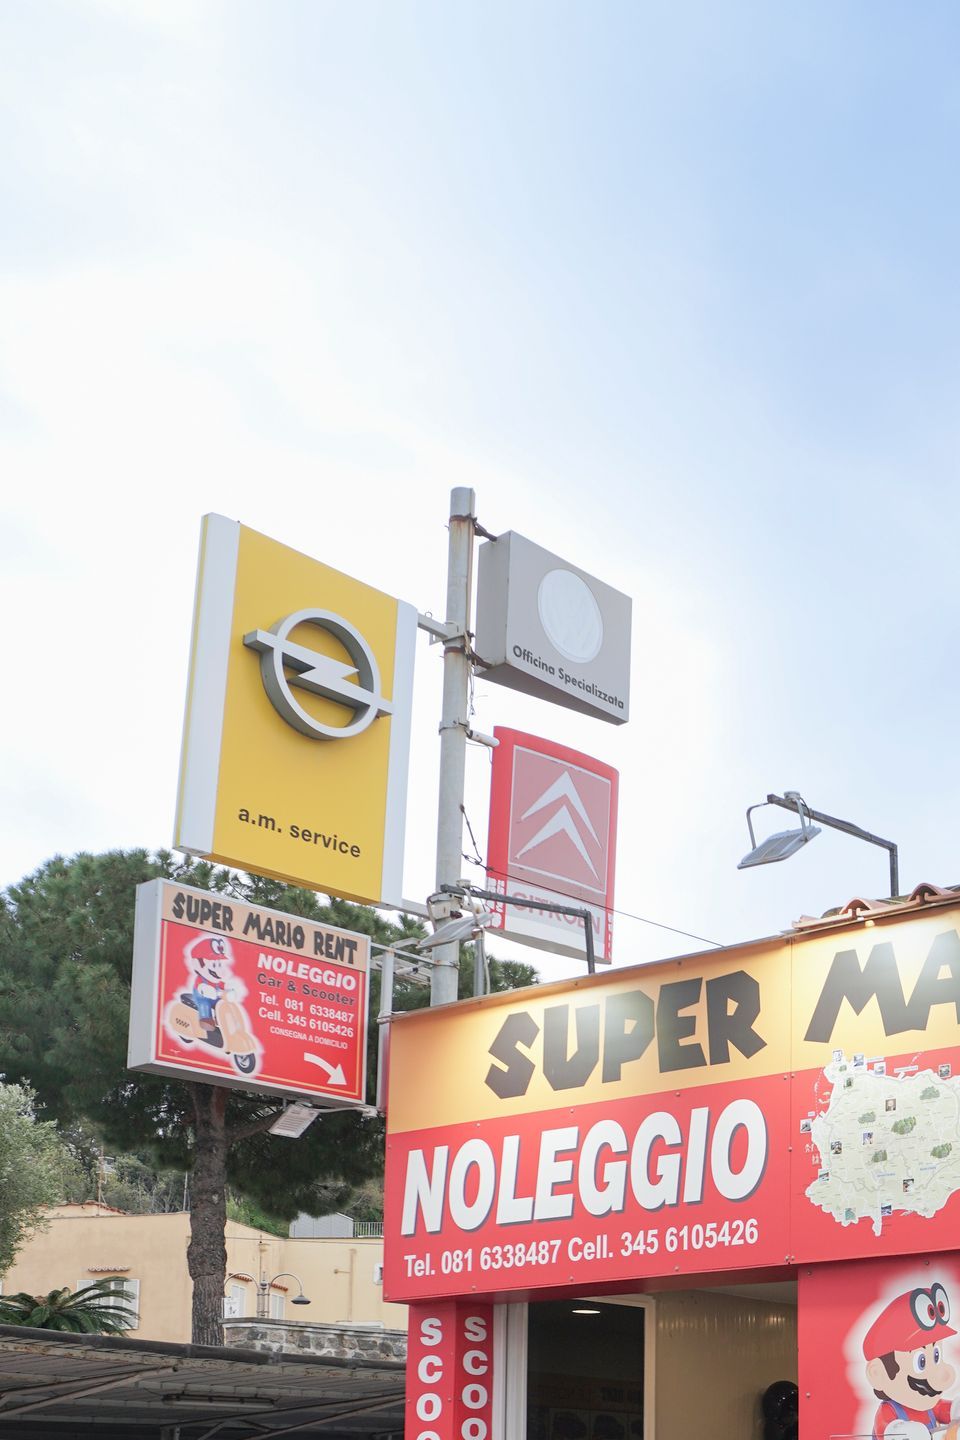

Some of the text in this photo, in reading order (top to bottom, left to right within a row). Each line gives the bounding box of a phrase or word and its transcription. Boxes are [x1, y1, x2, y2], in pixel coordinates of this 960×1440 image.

[513, 645, 624, 709] Officina Specializzata
[238, 808, 361, 858] a.m. service
[172, 892, 358, 965] SUPER MARIO RENT
[257, 953, 357, 991] NOLEGGIO
[257, 973, 355, 1006] Car & Scooter
[258, 1007, 354, 1038] Cell. 345 6105426
[259, 992, 354, 1023] Tel. 081 6338487
[270, 1026, 307, 1041] CONSEGNA
[315, 1036, 348, 1049] DOMICILIO
[485, 970, 767, 1098] SUPER
[401, 1099, 768, 1236] NOLEGGIO
[404, 1218, 759, 1279] Tel. 081 6338487 Cell. 345 6105426
